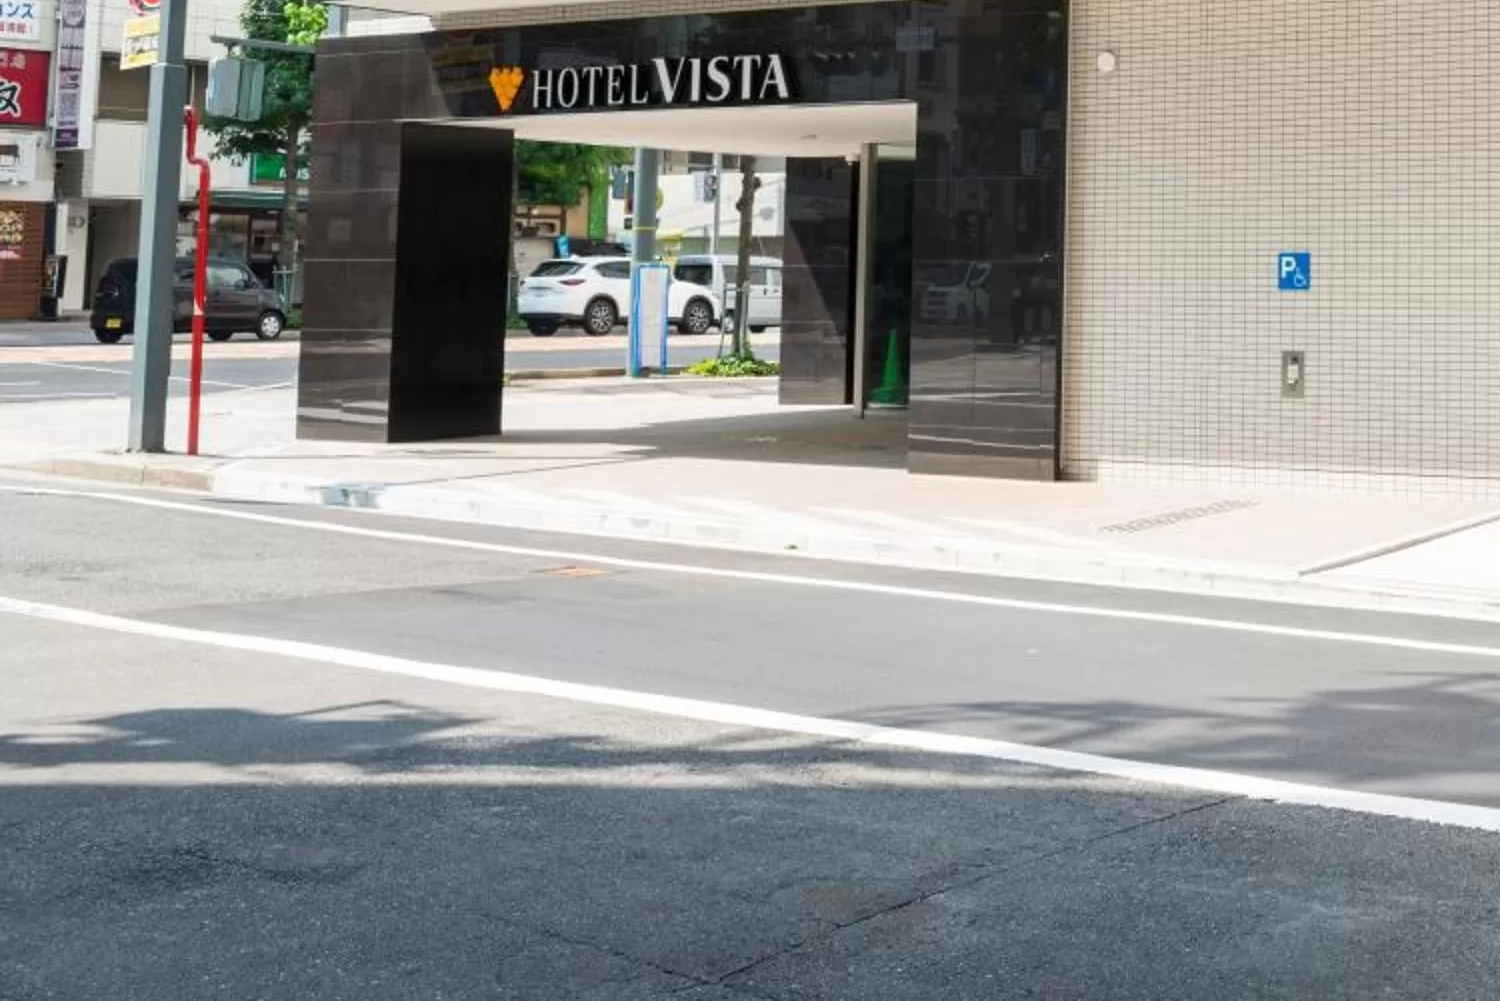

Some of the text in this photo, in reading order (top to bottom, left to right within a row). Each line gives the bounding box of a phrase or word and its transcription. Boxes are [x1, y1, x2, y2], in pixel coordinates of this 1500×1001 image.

[532, 54, 789, 108] HOTEL VISTA
[1280, 256, 1297, 279] P
